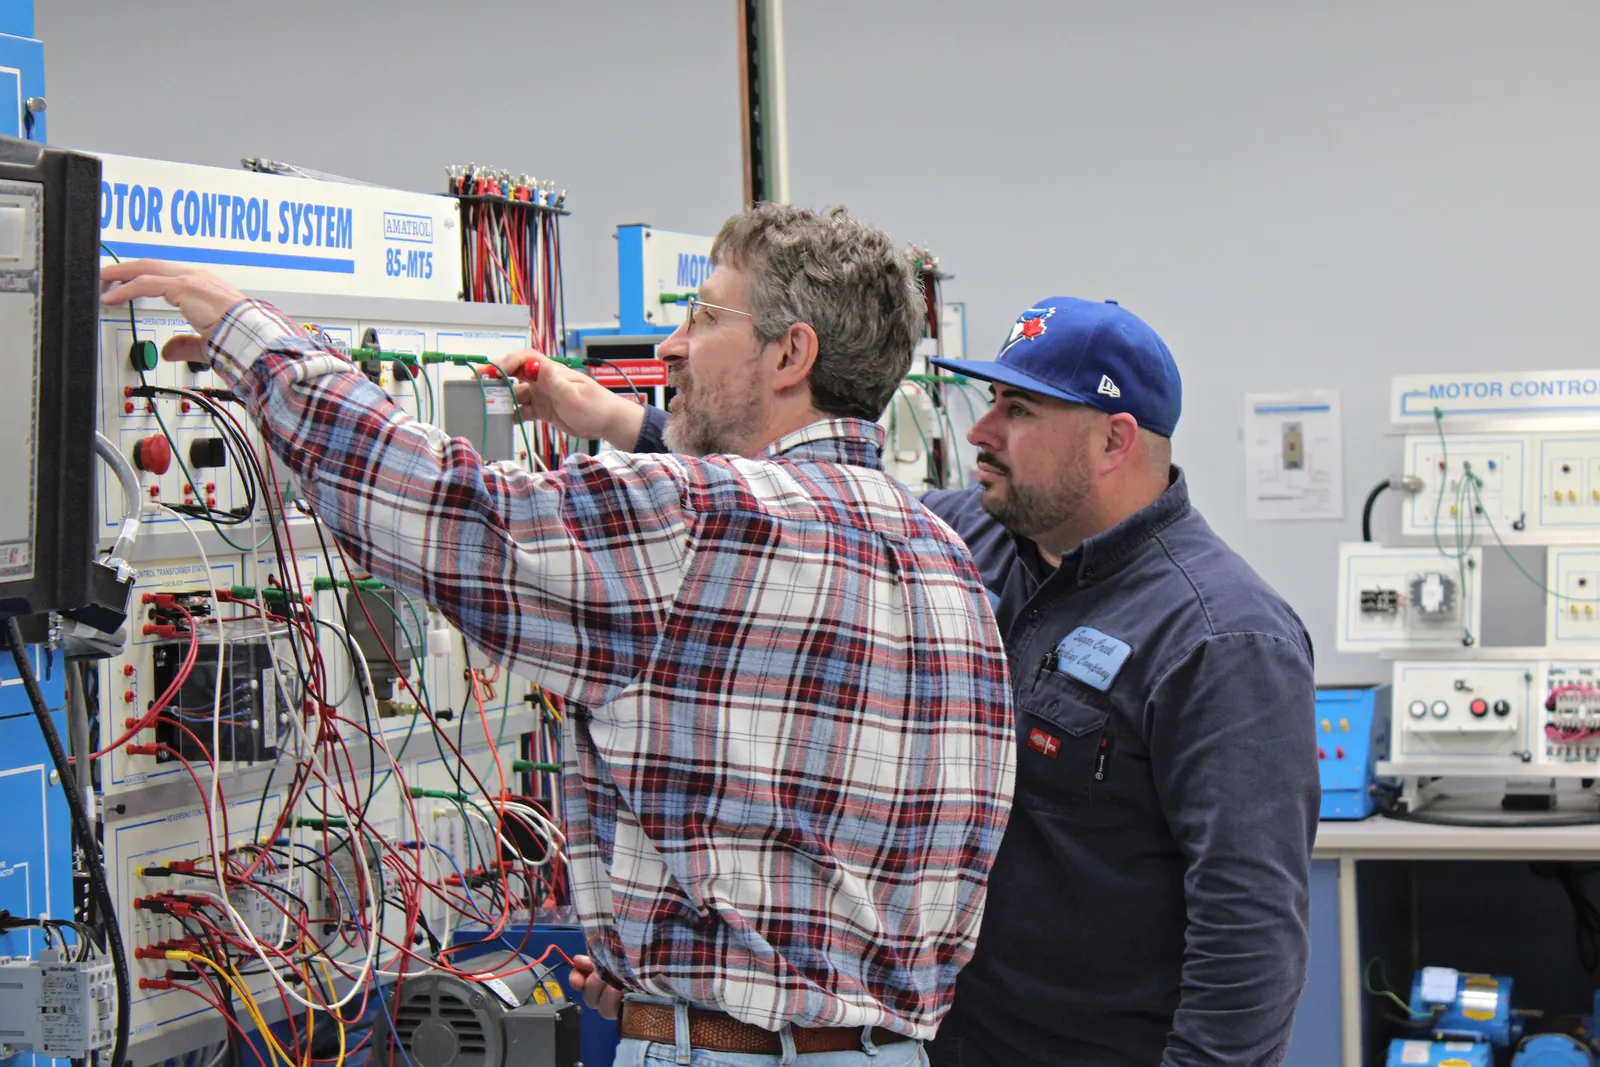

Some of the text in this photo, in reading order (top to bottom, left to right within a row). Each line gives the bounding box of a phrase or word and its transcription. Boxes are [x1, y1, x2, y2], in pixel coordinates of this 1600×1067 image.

[100, 181, 353, 249] OTOR CONTROL SYSTEM
[386, 218, 432, 237] AMATROL
[676, 253, 715, 288] MOTO
[1429, 379, 1600, 399] MOTOR CONTRO
[136, 563, 207, 579] ONTROL TRANSFORMER STATIO
[1077, 654, 1111, 682] Company
